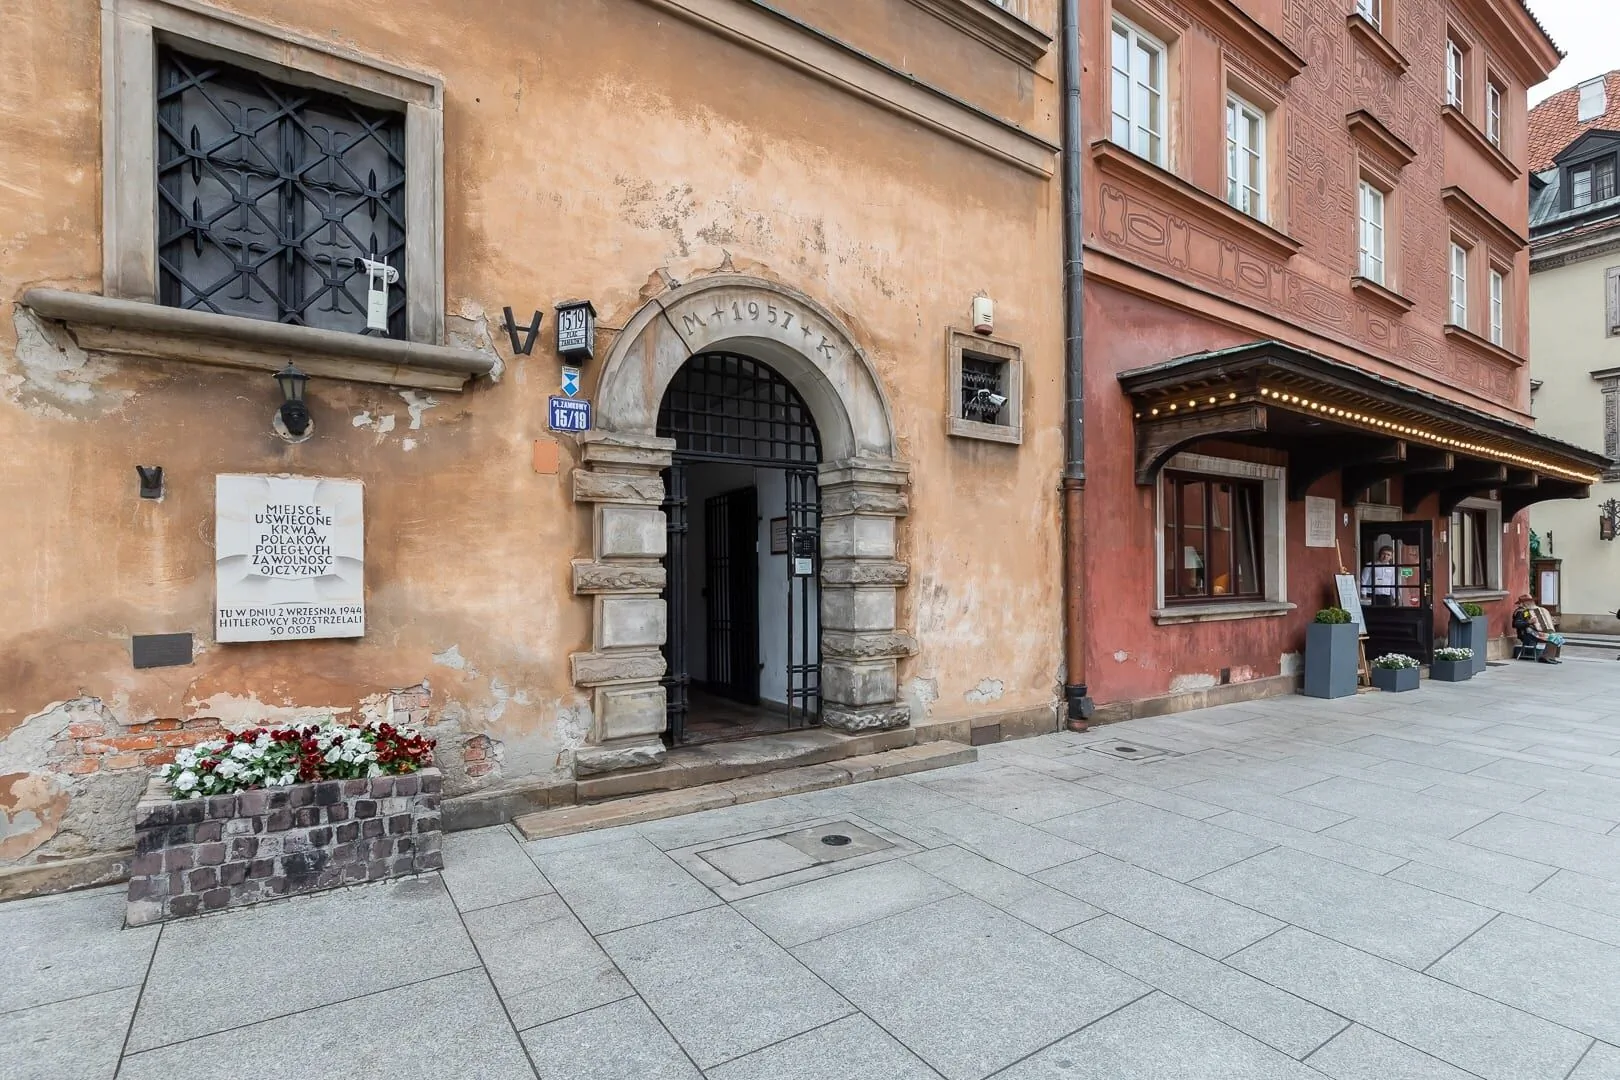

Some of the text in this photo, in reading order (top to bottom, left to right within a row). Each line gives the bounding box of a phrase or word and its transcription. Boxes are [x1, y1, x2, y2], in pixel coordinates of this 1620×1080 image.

[555, 409, 587, 429] 15/19
[266, 504, 321, 515] MIEJSCE
[255, 545, 330, 555] POLEGŁYCH
[252, 555, 269, 565] ZA
[261, 565, 327, 576] OJCZYZNY
[220, 609, 233, 618] TU
[249, 608, 276, 617] DNIU
[278, 607, 284, 616] 2
[340, 606, 362, 615] 1944
[219, 615, 362, 627] HITLEROWCY ROZSTRZELALI
[270, 626, 285, 635] 50
